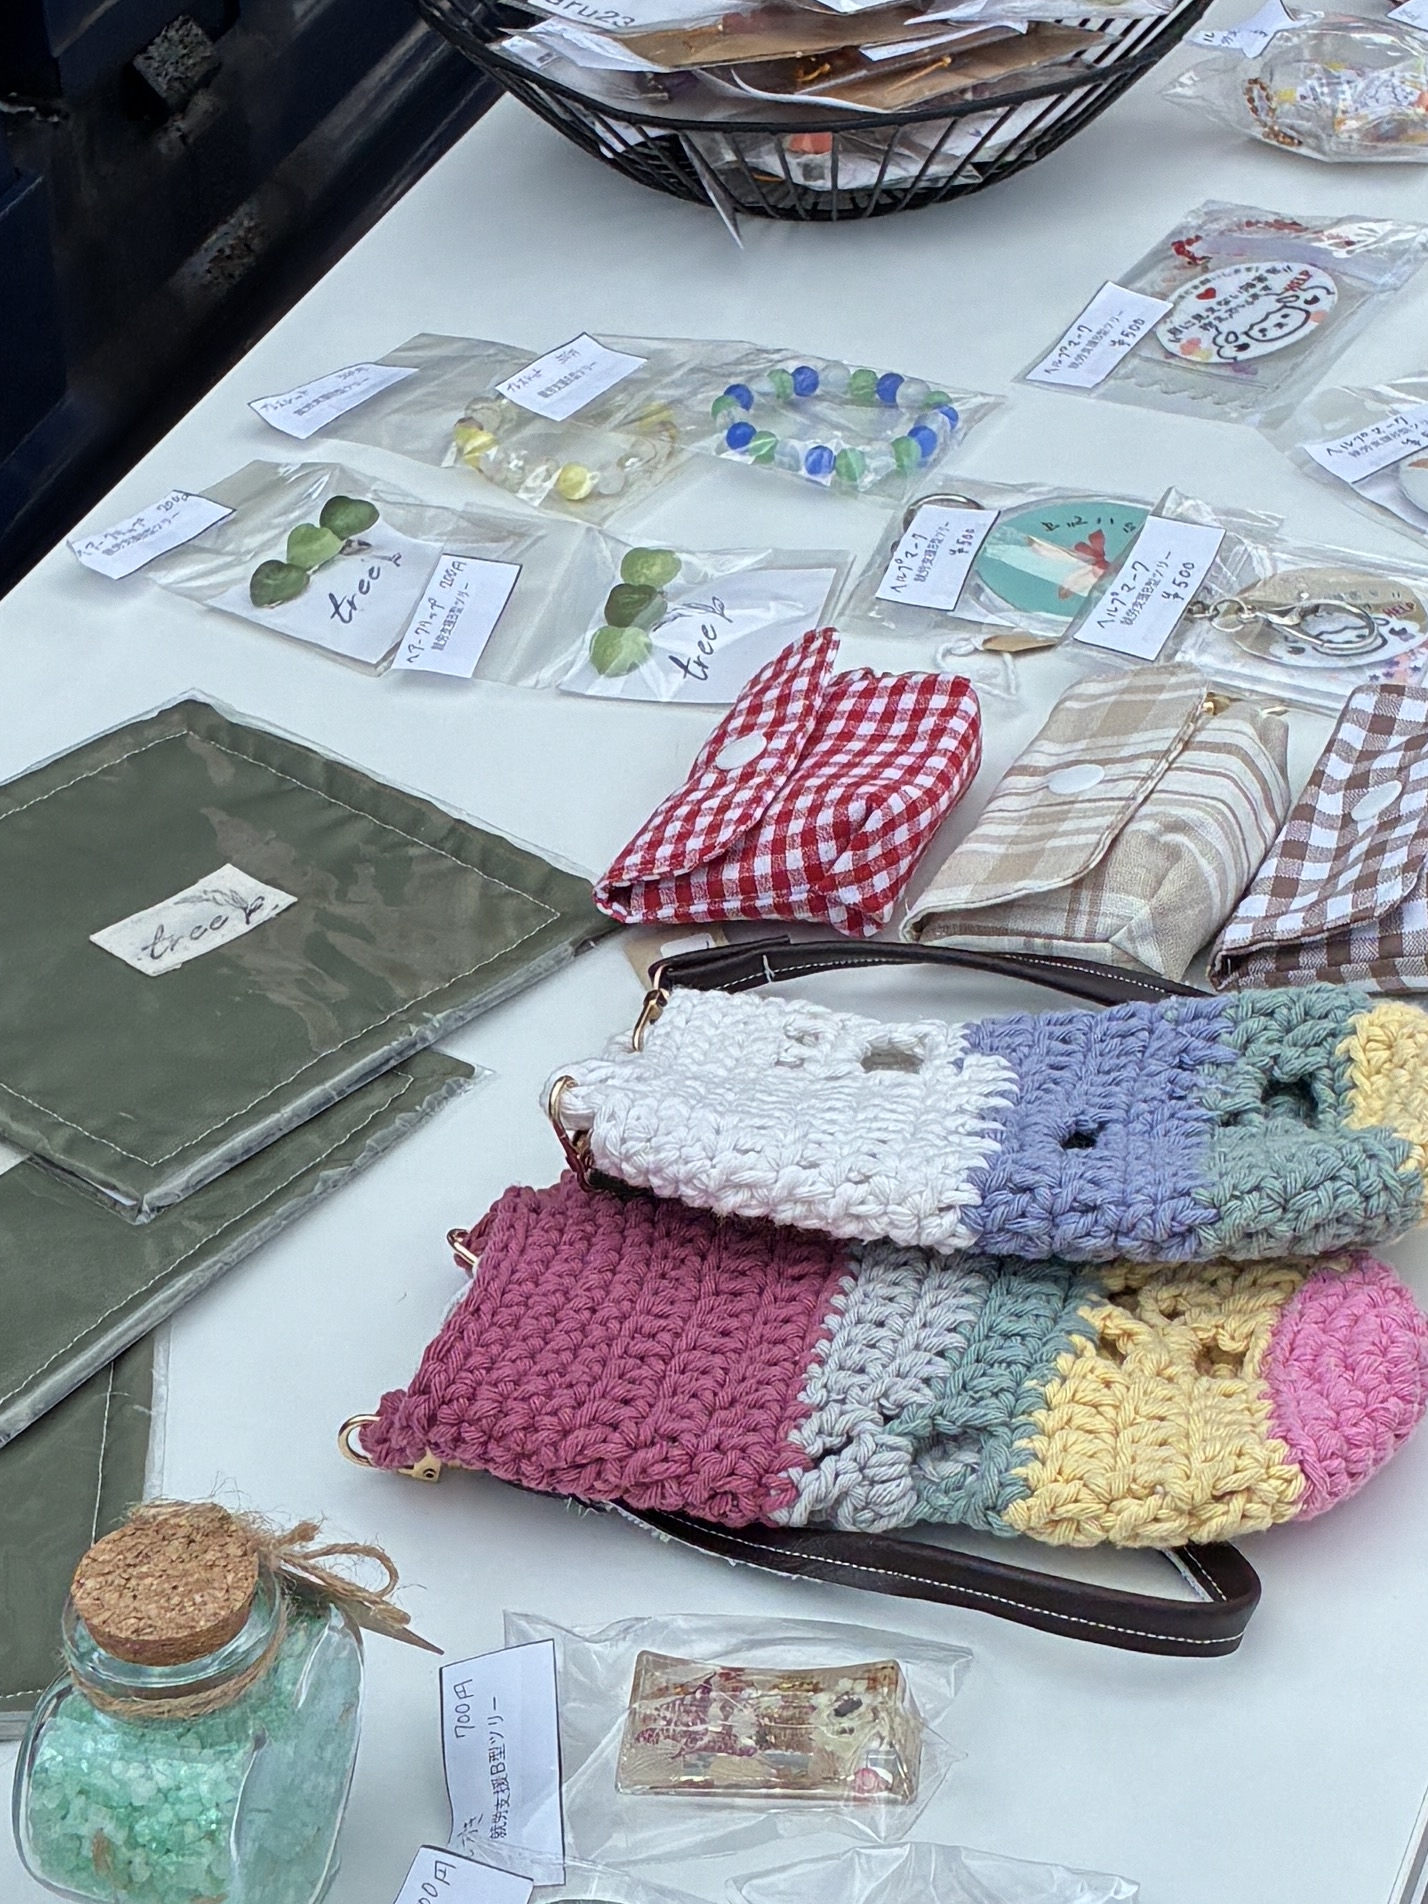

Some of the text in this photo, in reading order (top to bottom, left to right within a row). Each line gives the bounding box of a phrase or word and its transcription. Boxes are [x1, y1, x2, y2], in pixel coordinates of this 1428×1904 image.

[326, 565, 382, 625] tree
[1160, 560, 1196, 603] ¥500
[667, 623, 719, 683] tree
[141, 912, 231, 962] tree
[453, 1677, 475, 1740] 700円
[487, 1696, 511, 1840] 就労支援B型ツリー
